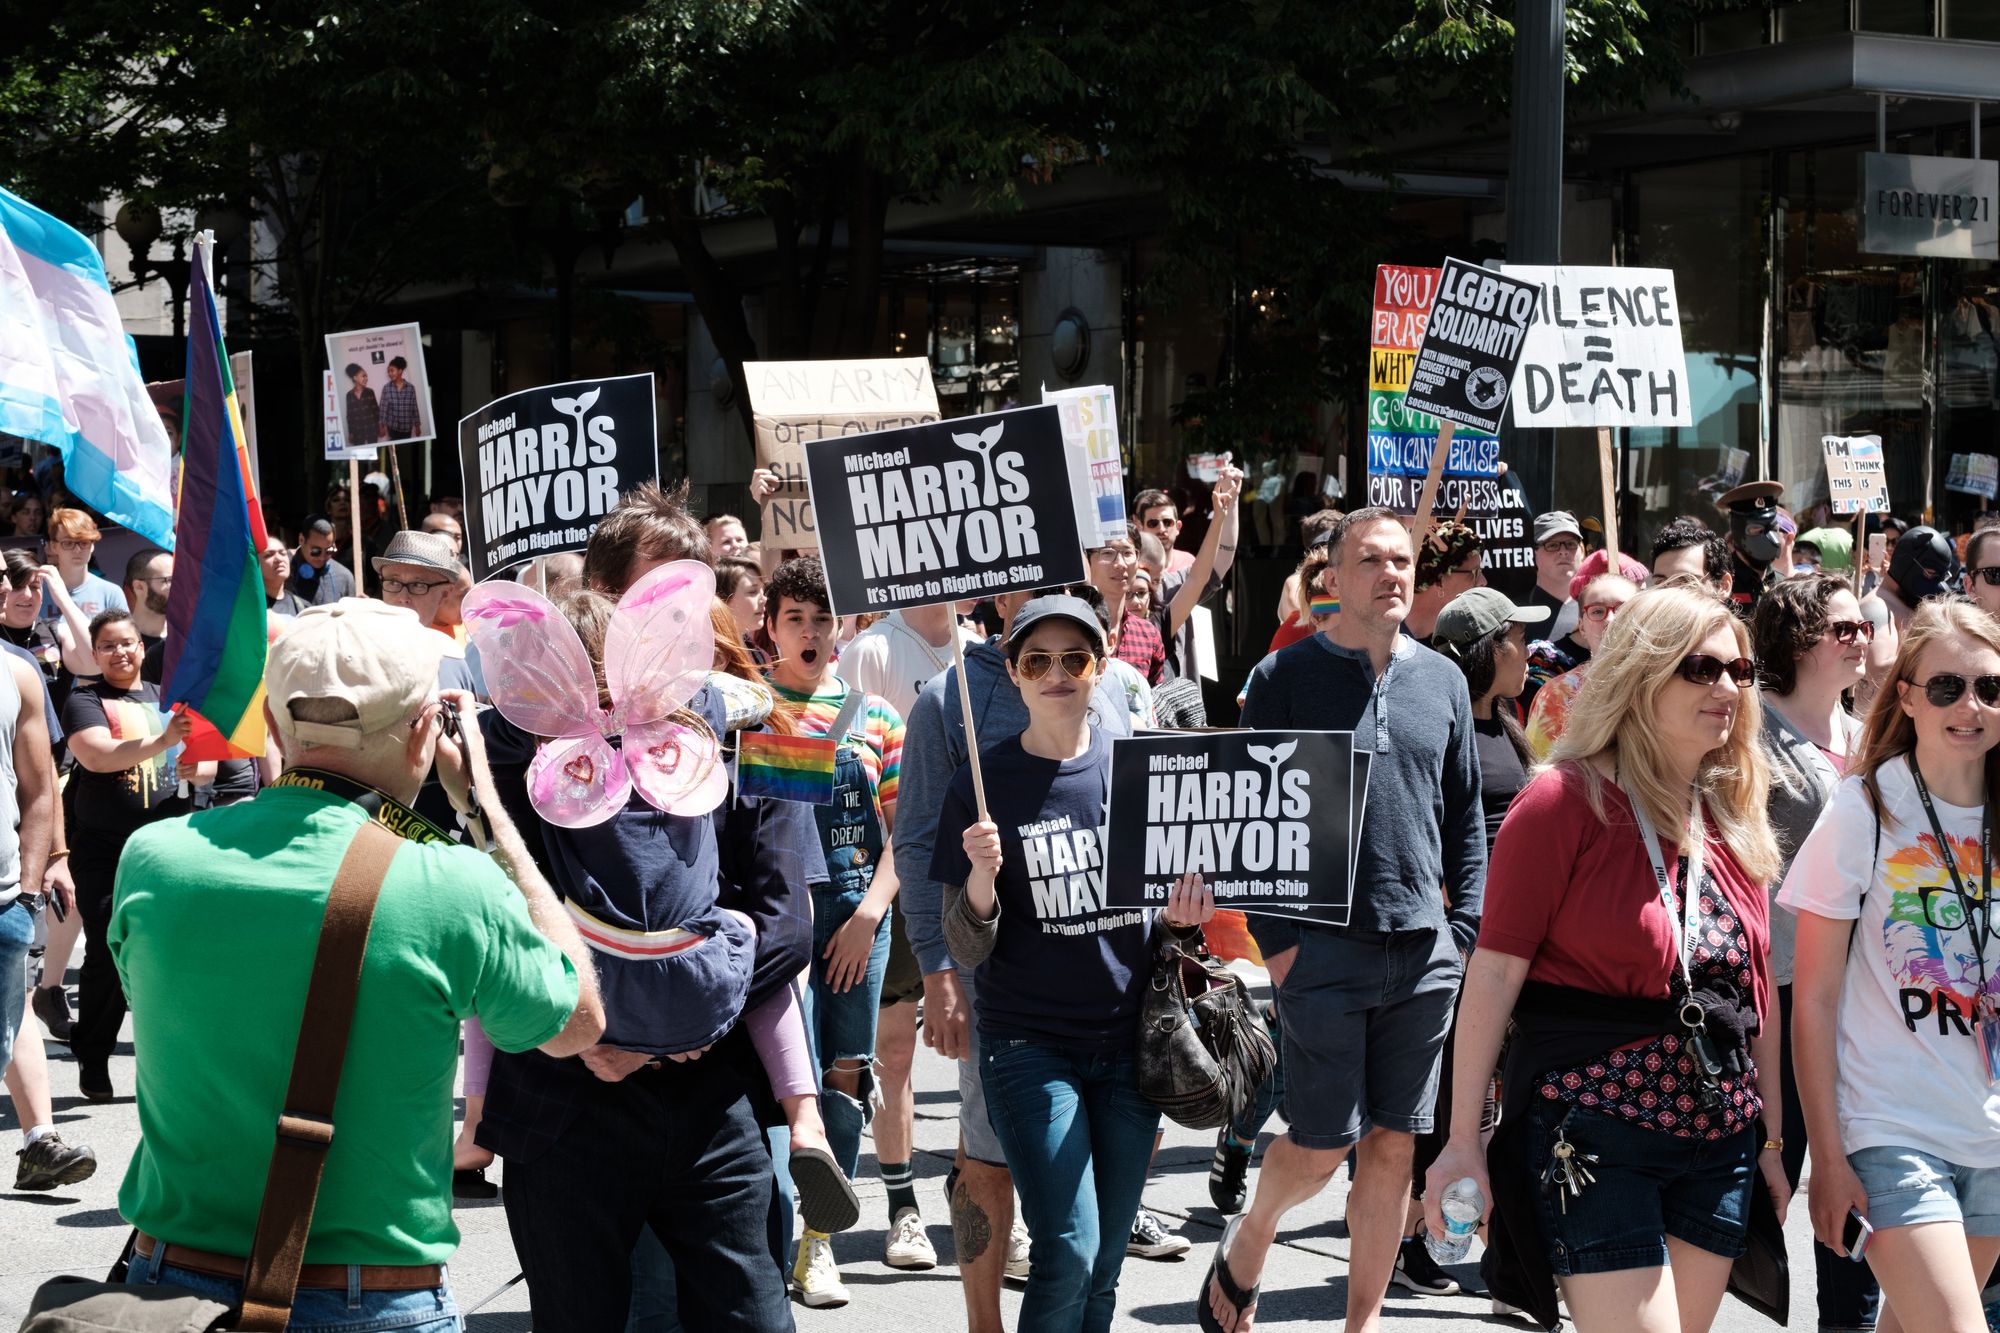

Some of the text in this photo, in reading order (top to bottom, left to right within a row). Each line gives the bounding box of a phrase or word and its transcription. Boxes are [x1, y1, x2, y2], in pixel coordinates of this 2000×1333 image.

[1878, 190, 1988, 222] FOREVER 21
[1441, 266, 1533, 330] LGBTQ
[1531, 282, 1673, 328] ILENCE
[1428, 303, 1526, 361] SOLIDARITY
[1419, 359, 1460, 379] REFUGEES & ALL
[1422, 348, 1471, 372] WITH IMMIGRANTS,
[763, 367, 926, 403] AN ARMY
[1412, 381, 1433, 395] PEOPLE
[1415, 370, 1446, 387] OPPRESSED
[1525, 362, 1677, 417] DEATH
[478, 412, 516, 444] Michael
[1407, 396, 1444, 414] SOCIALIST
[1453, 411, 1496, 431] ALTERNATIVE
[479, 388, 617, 493] HARRIS
[775, 422, 809, 443] OF
[1826, 441, 1849, 456] I'M
[844, 447, 911, 473] Michael
[1370, 435, 1401, 467] YOU
[1450, 439, 1499, 473] ERASE
[1845, 461, 1880, 470] I THINK
[847, 421, 1030, 525] HARRIS
[1834, 479, 1869, 488] THIS IS
[482, 465, 620, 545] MAYOR
[1370, 477, 1498, 511] OUR POGRESS
[855, 505, 1040, 580] MAYOR
[1475, 518, 1524, 539] LIVES
[487, 551, 498, 568] It's
[497, 543, 517, 562] Time
[517, 538, 528, 553] to
[529, 528, 563, 550] Right
[564, 526, 587, 543] the
[867, 564, 1044, 605] It's Time to Right the Ship
[1150, 752, 1209, 772] Michael
[1147, 739, 1311, 823] HARRIS
[843, 791, 861, 808] THE
[379, 802, 427, 841] D750
[831, 825, 865, 847] DREAM
[1018, 814, 1072, 837] Michael
[1144, 820, 1311, 875] MAYOR
[1144, 883, 1165, 899] It's
[1214, 880, 1248, 898] Right
[1250, 879, 1273, 896] the
[1275, 879, 1309, 898] Ship
[1057, 923, 1086, 936] Time
[1086, 921, 1096, 933] to
[1097, 915, 1124, 931] Right
[1124, 911, 1141, 924] the
